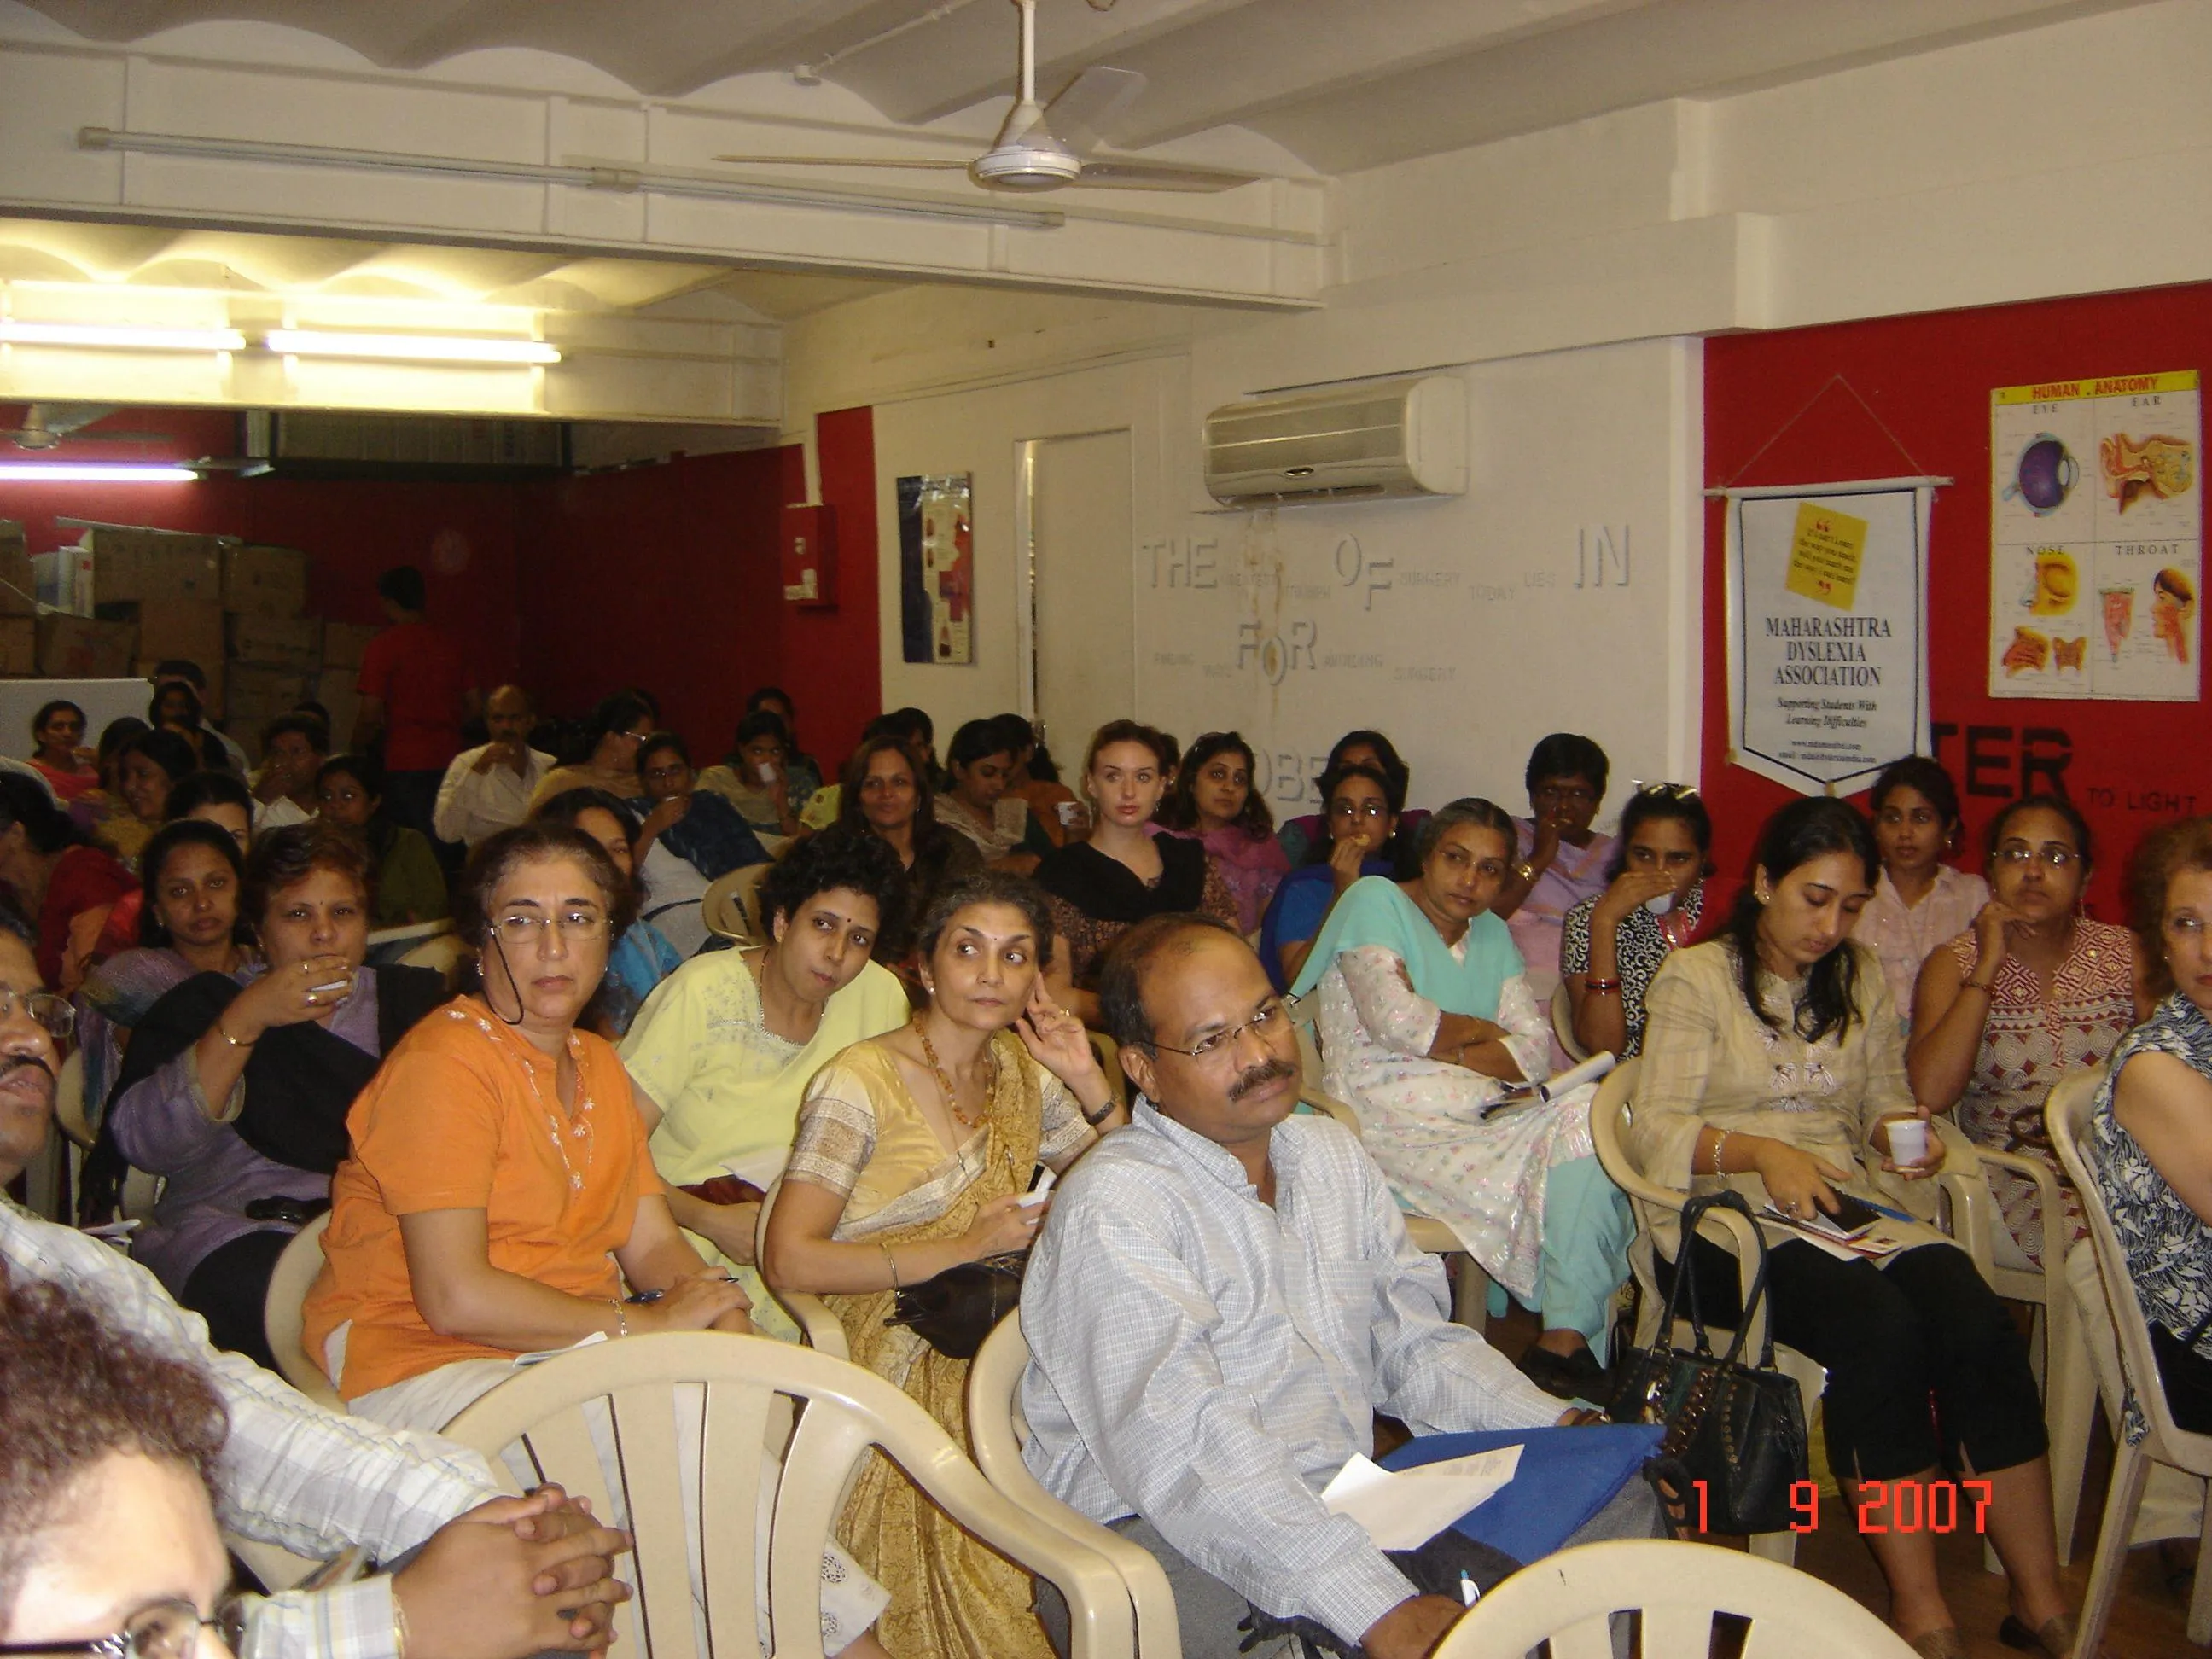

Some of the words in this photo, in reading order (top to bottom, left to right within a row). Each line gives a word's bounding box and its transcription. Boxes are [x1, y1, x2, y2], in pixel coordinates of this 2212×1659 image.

[2032, 383, 2080, 400] HUMAN
[2094, 376, 2159, 395] ANATOMY
[2032, 404, 2059, 415] EYE
[2131, 395, 2163, 407] EAR
[2026, 545, 2065, 555] NOSE
[2116, 544, 2180, 556] THROAT
[1143, 538, 1218, 589] THE
[1336, 533, 1394, 612] OF
[1468, 585, 1516, 602] TODAY
[1574, 523, 1631, 590] IN
[1765, 616, 1892, 637] MAHARASHTRA
[1237, 620, 1318, 687] FOR
[1786, 641, 1866, 661] DYSLEXIA
[1774, 665, 1882, 687] ASSOCIATION
[1778, 696, 1820, 712] Supporting
[1820, 698, 1855, 711] Students
[1858, 699, 1877, 711] With
[1785, 713, 1822, 728] Learning
[1823, 715, 1867, 729] Difficulties
[2087, 787, 2115, 807] TO
[2128, 789, 2197, 812] LIGHT
